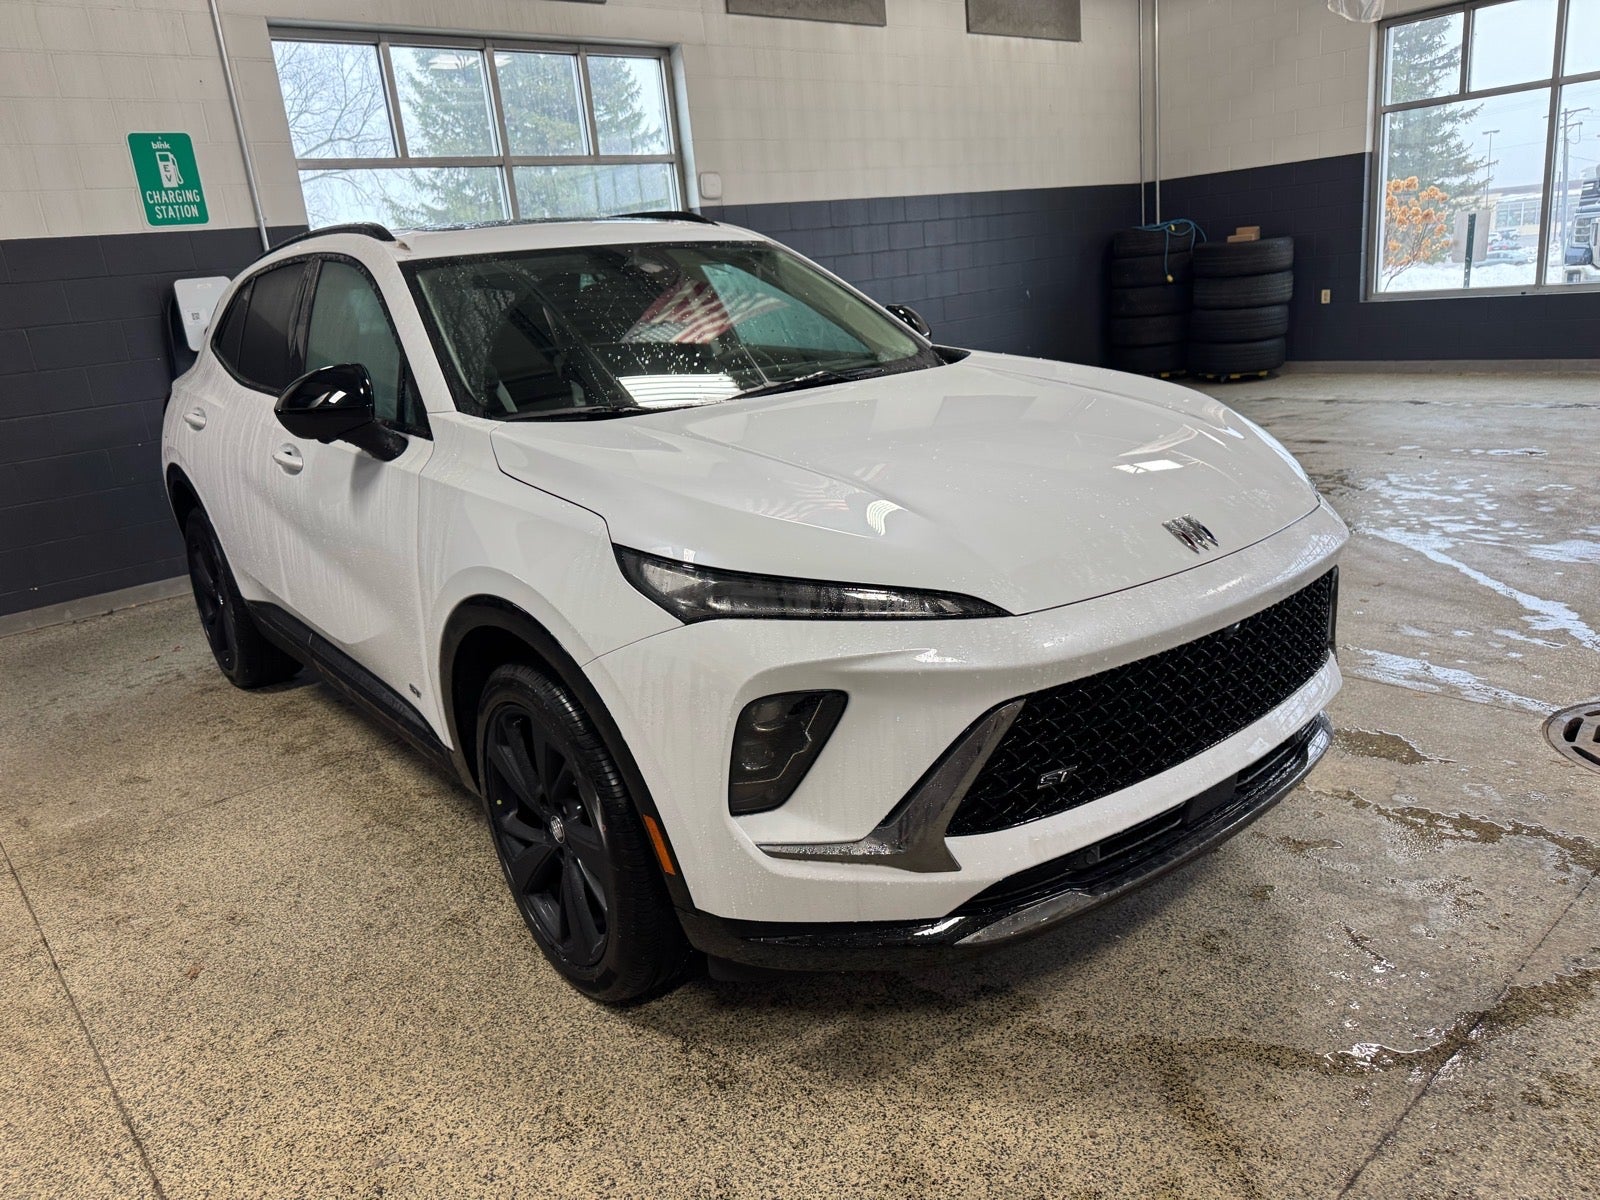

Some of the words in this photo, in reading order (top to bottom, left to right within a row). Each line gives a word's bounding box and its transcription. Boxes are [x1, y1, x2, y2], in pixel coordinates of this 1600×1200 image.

[151, 139, 171, 149] blink
[146, 189, 200, 204] CHARGING
[155, 204, 199, 219] STATION
[1037, 765, 1078, 789] ST
